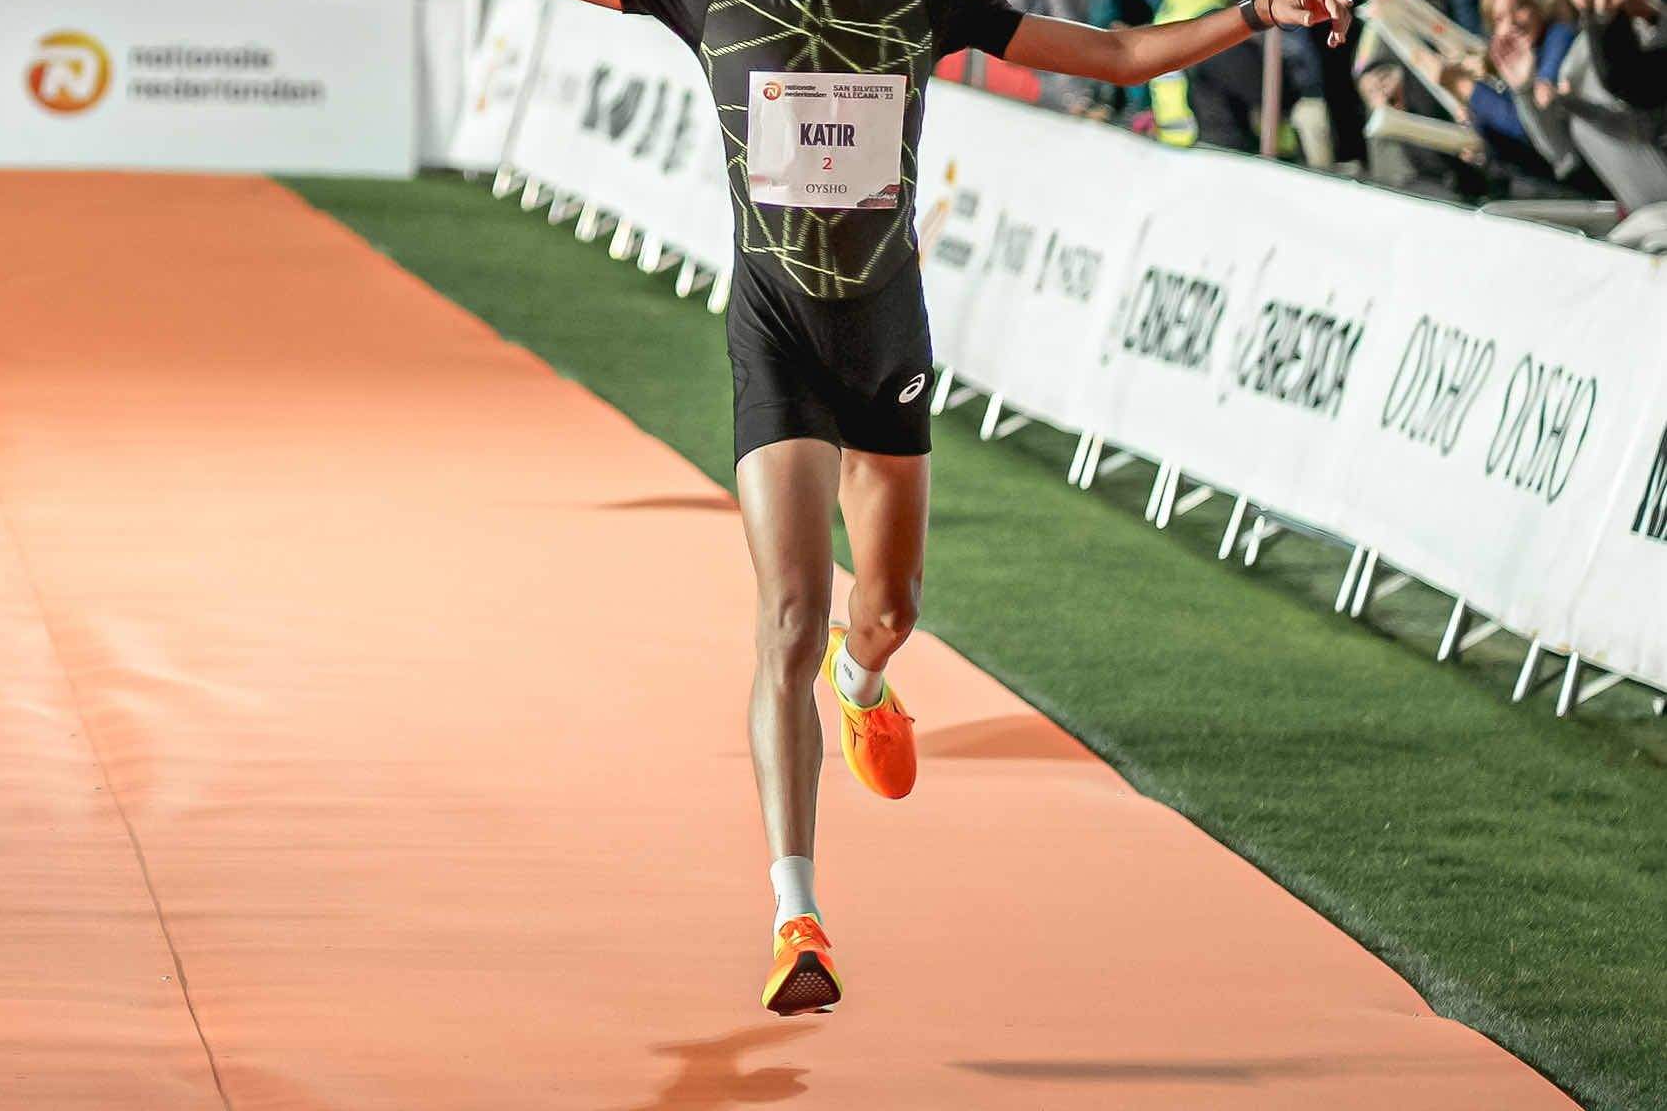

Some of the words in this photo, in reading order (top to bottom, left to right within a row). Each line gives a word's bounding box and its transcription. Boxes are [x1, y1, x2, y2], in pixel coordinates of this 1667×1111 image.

[852, 85, 894, 93] SILVESTRE
[800, 123, 856, 147] KATIR
[822, 157, 833, 170] 2
[805, 183, 848, 194] OYSHO
